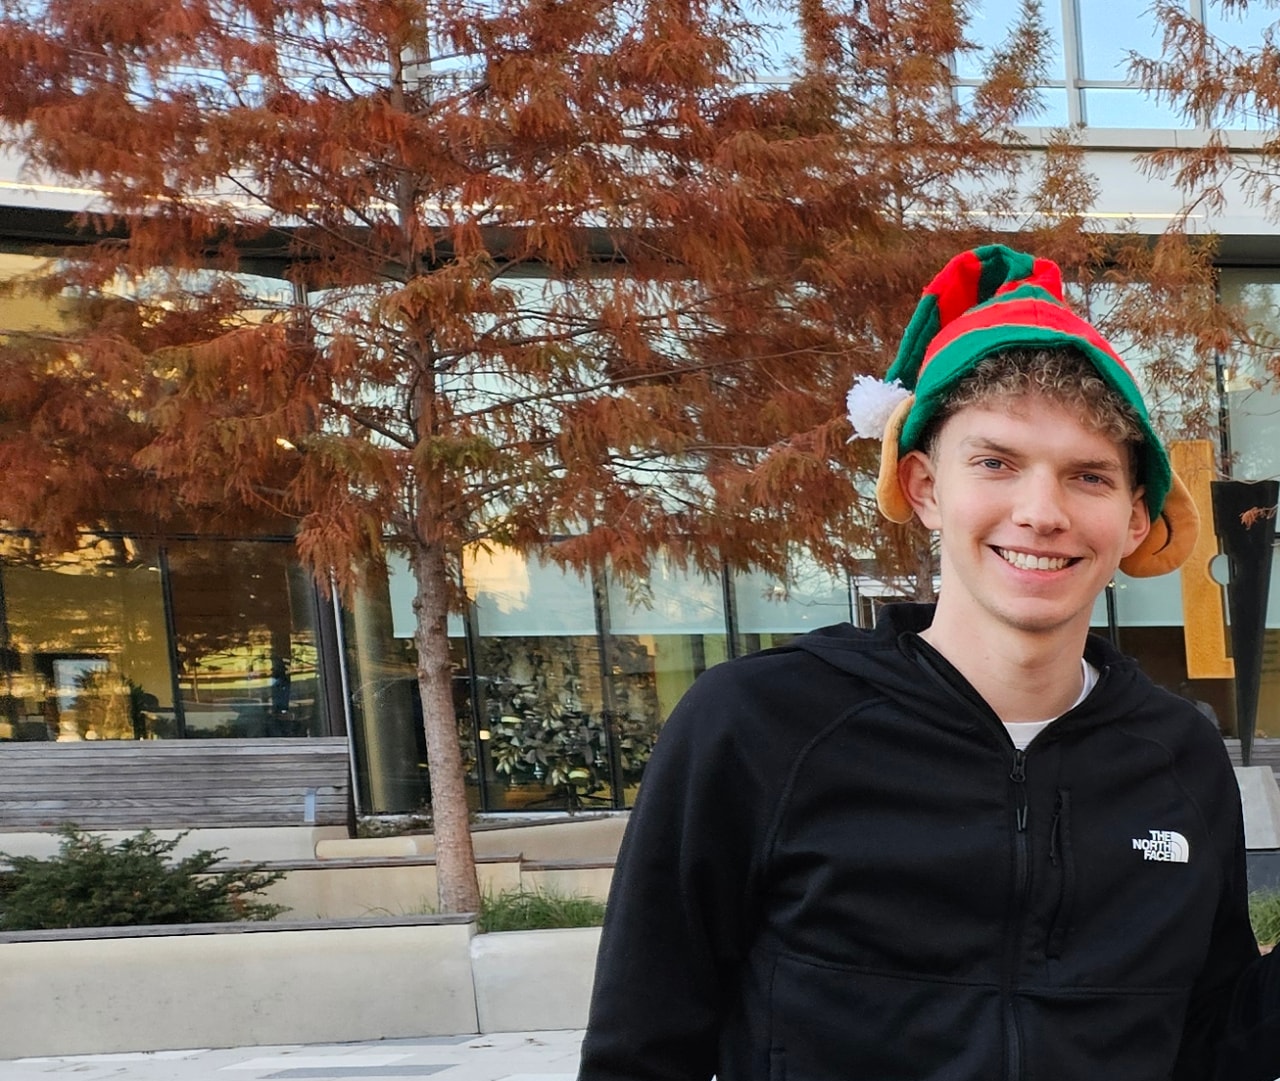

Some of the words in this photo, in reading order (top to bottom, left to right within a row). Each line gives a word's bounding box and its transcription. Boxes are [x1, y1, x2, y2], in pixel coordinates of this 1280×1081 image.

[1149, 830, 1171, 841] THE
[1132, 838, 1171, 851] NORTH
[1144, 850, 1171, 861] FACE
